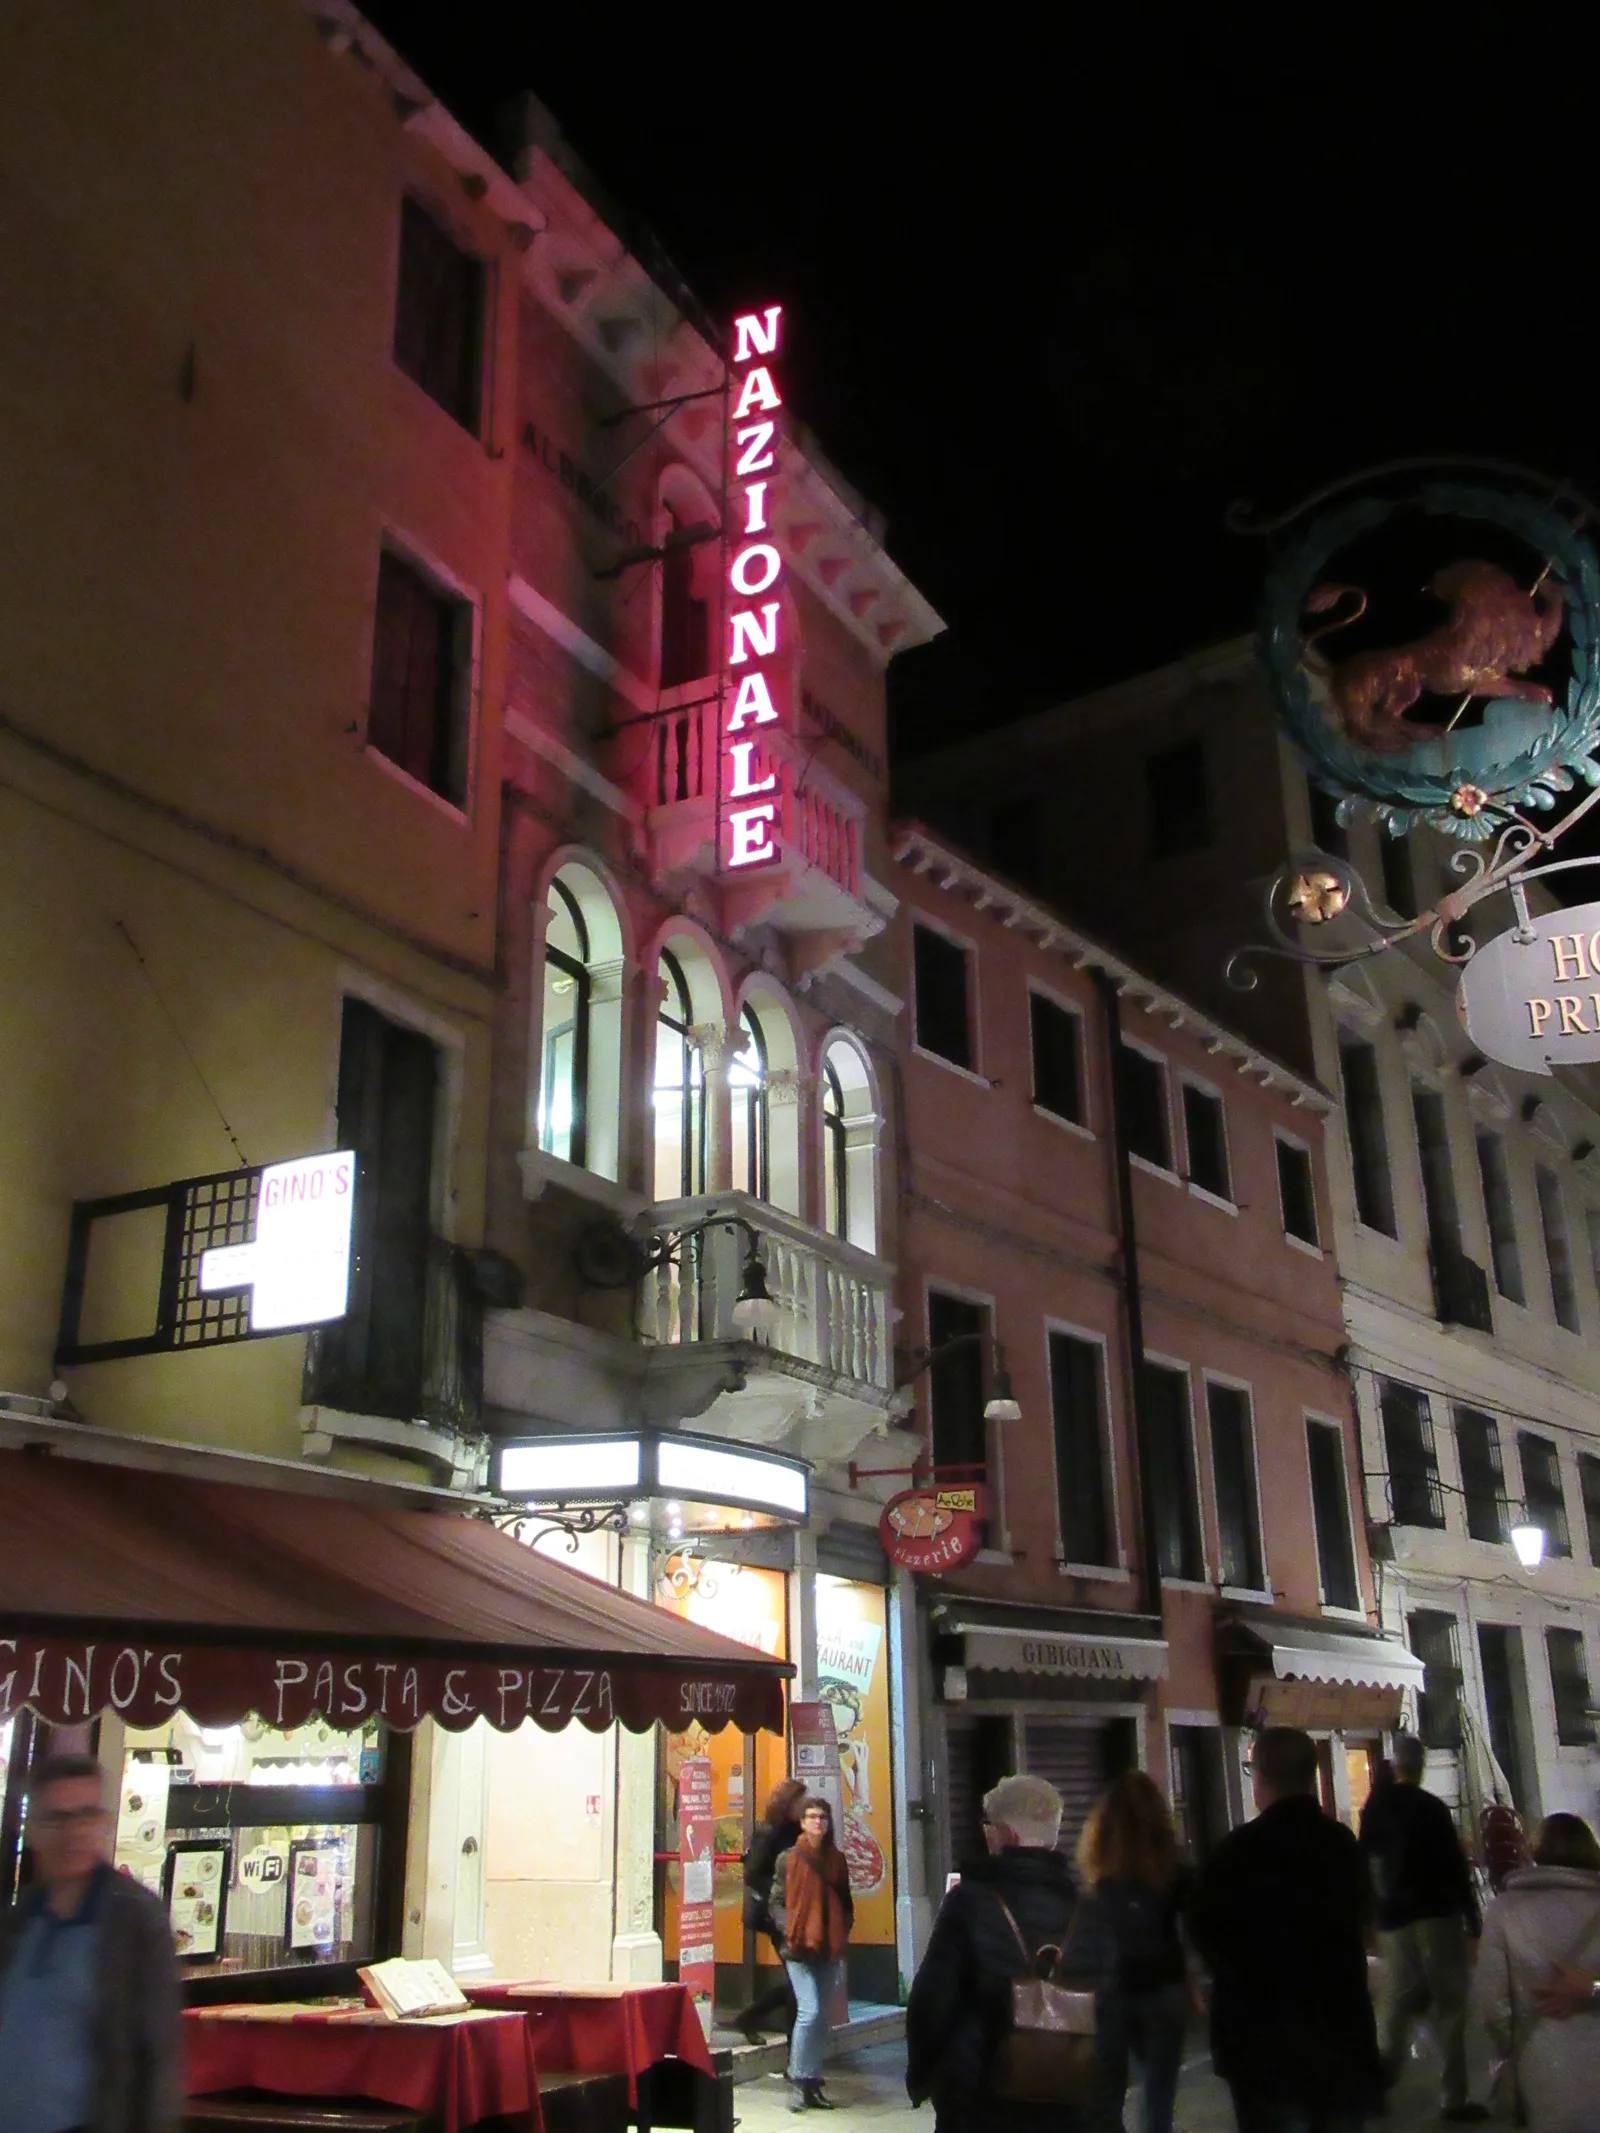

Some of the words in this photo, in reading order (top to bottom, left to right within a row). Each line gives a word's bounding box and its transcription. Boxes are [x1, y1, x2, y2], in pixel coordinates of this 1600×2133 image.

[728, 306, 783, 868] NAZIONALE
[264, 1163, 350, 1208] GINO'S
[1022, 1642, 1124, 1670] GIBIGIANA
[274, 1660, 419, 1723] PASTA
[442, 1669, 476, 1715] &
[497, 1668, 614, 1726] PIZZA
[680, 1682, 713, 1712] SINCE
